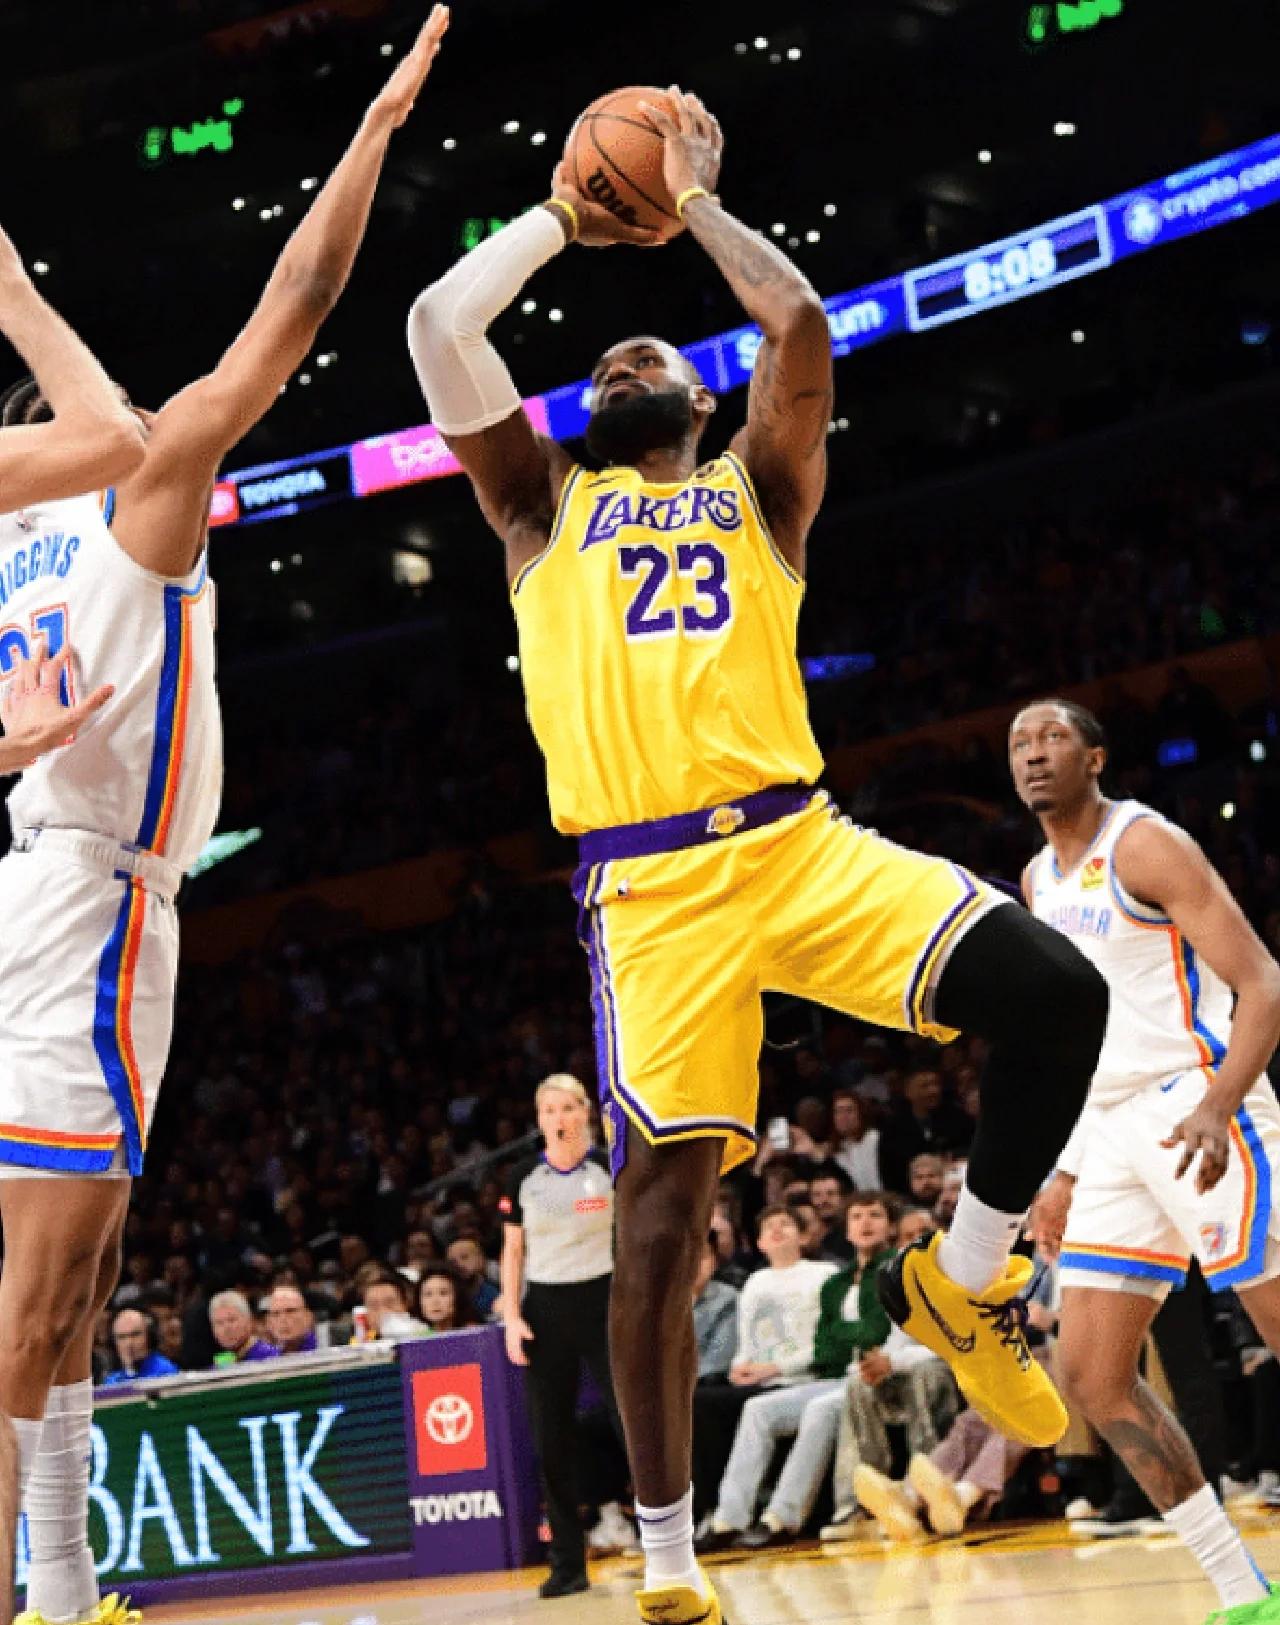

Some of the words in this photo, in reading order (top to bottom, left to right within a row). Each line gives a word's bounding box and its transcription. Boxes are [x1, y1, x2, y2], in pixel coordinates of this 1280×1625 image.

[579, 487, 743, 552] LAKERS
[617, 541, 736, 639] 23
[409, 1489, 504, 1525] TOYOTA
